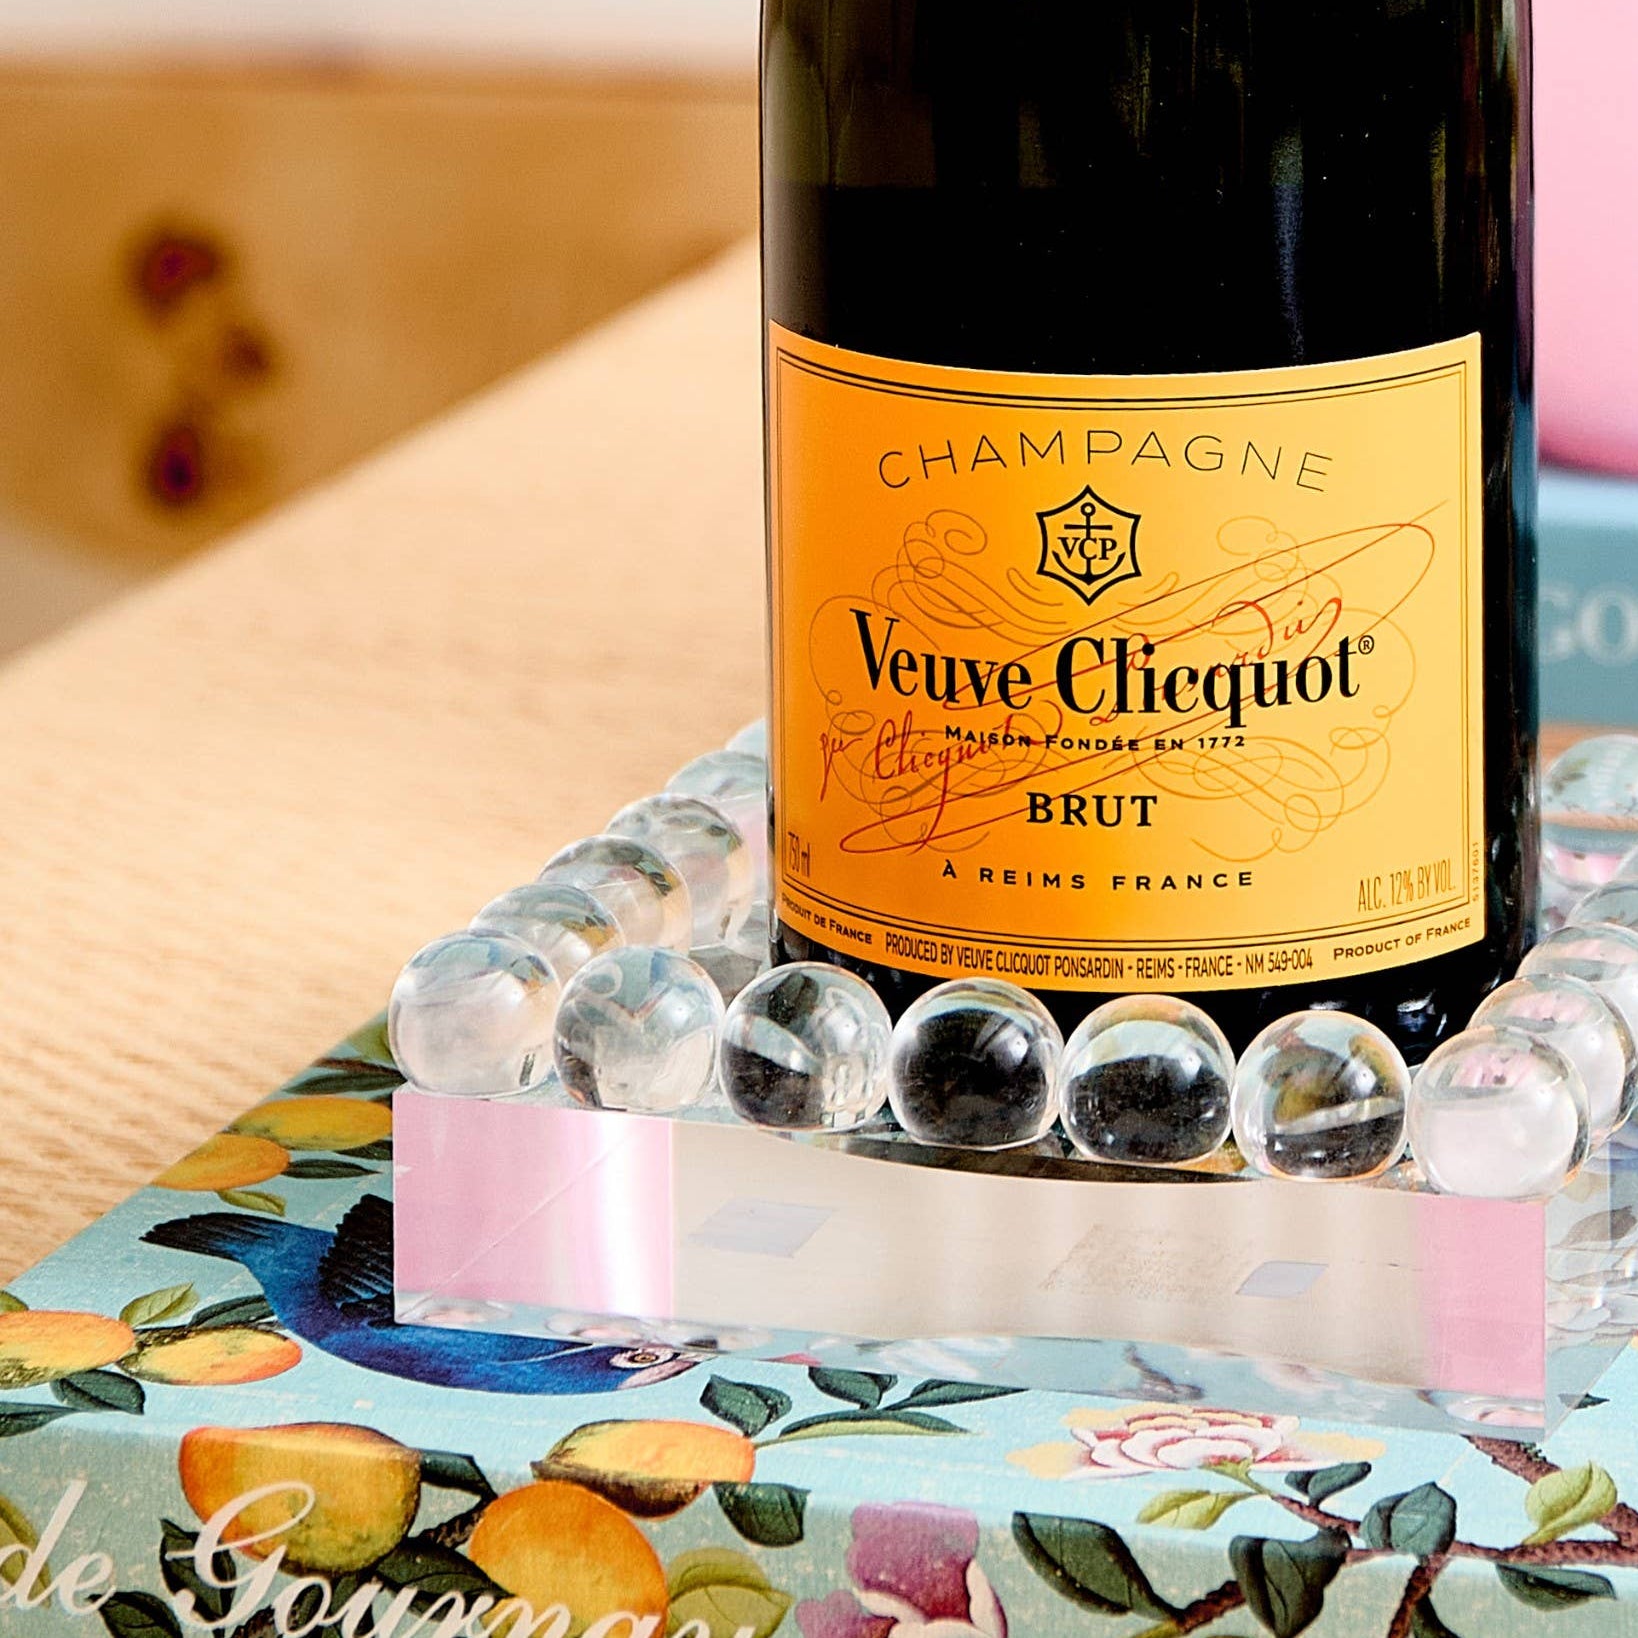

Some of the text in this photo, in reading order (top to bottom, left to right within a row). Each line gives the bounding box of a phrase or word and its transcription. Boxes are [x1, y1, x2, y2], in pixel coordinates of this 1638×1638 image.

[879, 429, 1333, 493] CHAMPAGNE
[1057, 536, 1118, 561] VCP
[849, 608, 1032, 710] Veuve
[945, 725, 1245, 751] MAISON FONDÉE EN 1772
[1026, 791, 1158, 827] BRUT
[942, 859, 1253, 891] À REIMS FRANCE
[1358, 858, 1456, 913] ALC. 12% BY VOL.
[781, 892, 873, 945] PRODUIT DE FRANCE
[1333, 917, 1471, 961] PRODUCT OF FRANCE
[885, 931, 1313, 980] PRODUCED BY VEUVE CLICQUOT PONSARDIN REIMS FRANCE NM 549-004
[0, 1479, 757, 1638] de Gourn
